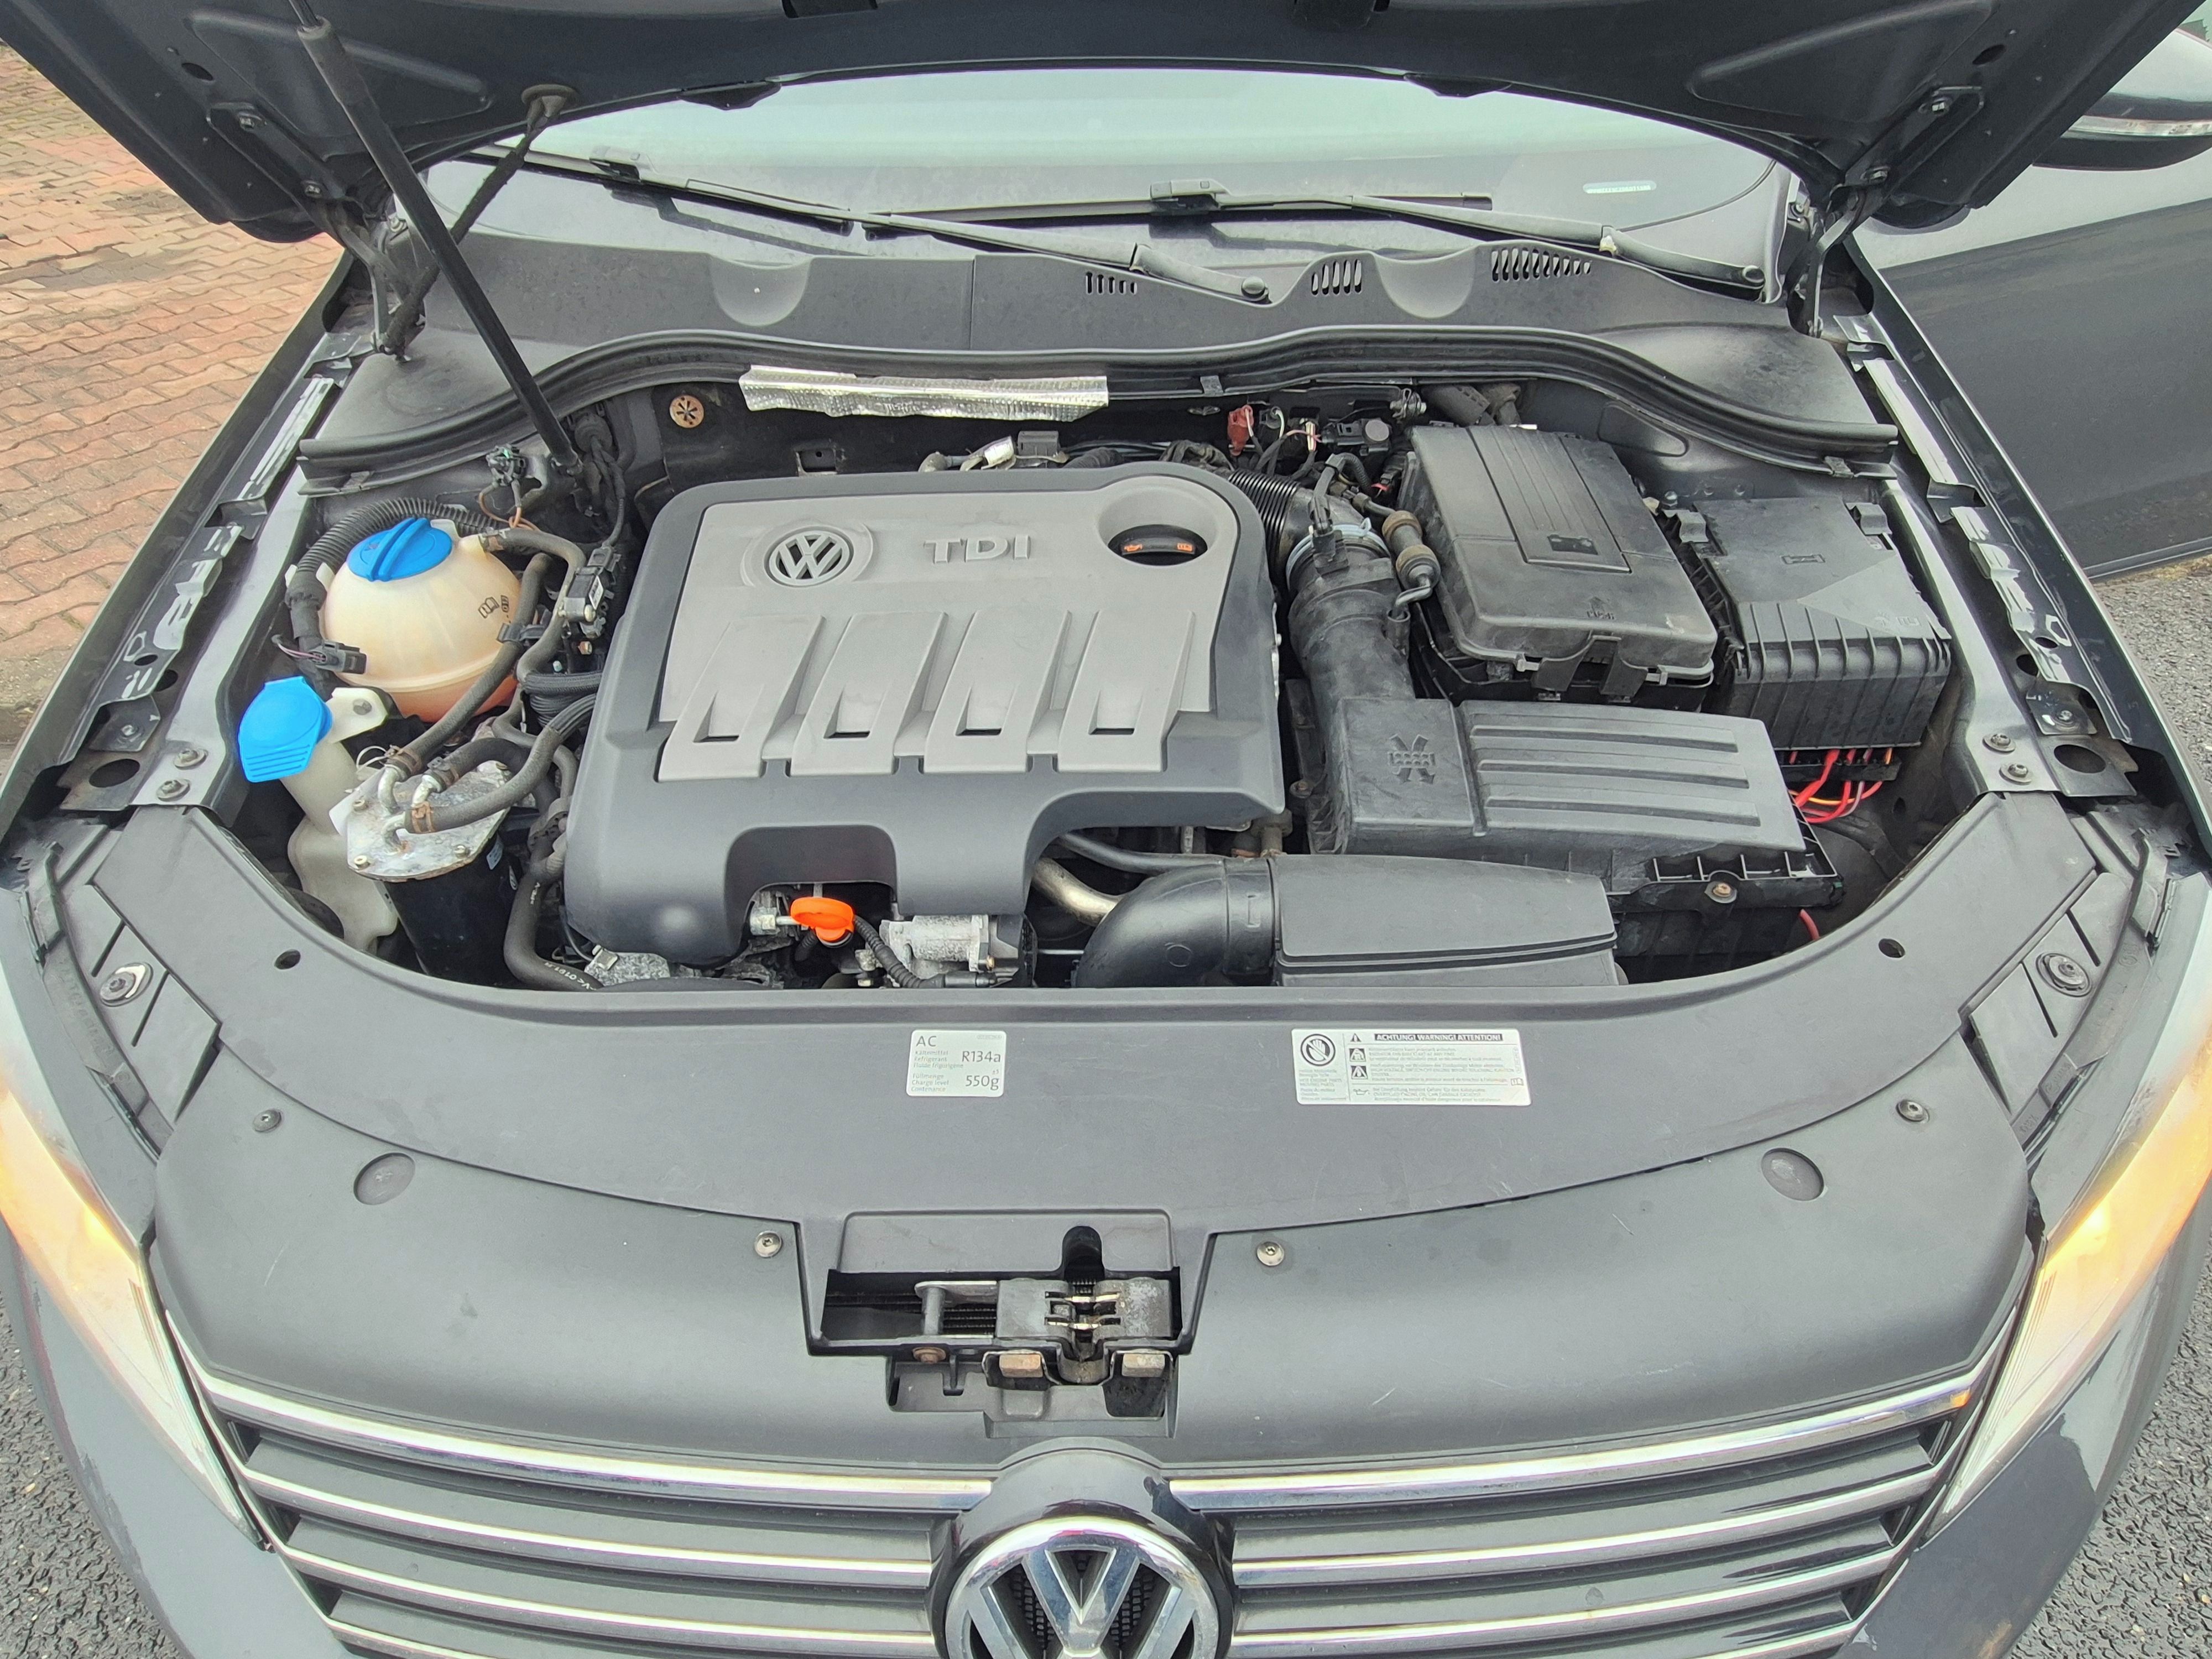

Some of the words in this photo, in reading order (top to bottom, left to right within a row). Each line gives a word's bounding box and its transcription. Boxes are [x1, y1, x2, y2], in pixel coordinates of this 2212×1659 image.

[924, 535, 1030, 563] TDI
[916, 1035, 937, 1047] AC
[962, 1051, 1000, 1062] R134a
[966, 1075, 1000, 1091] 550g
